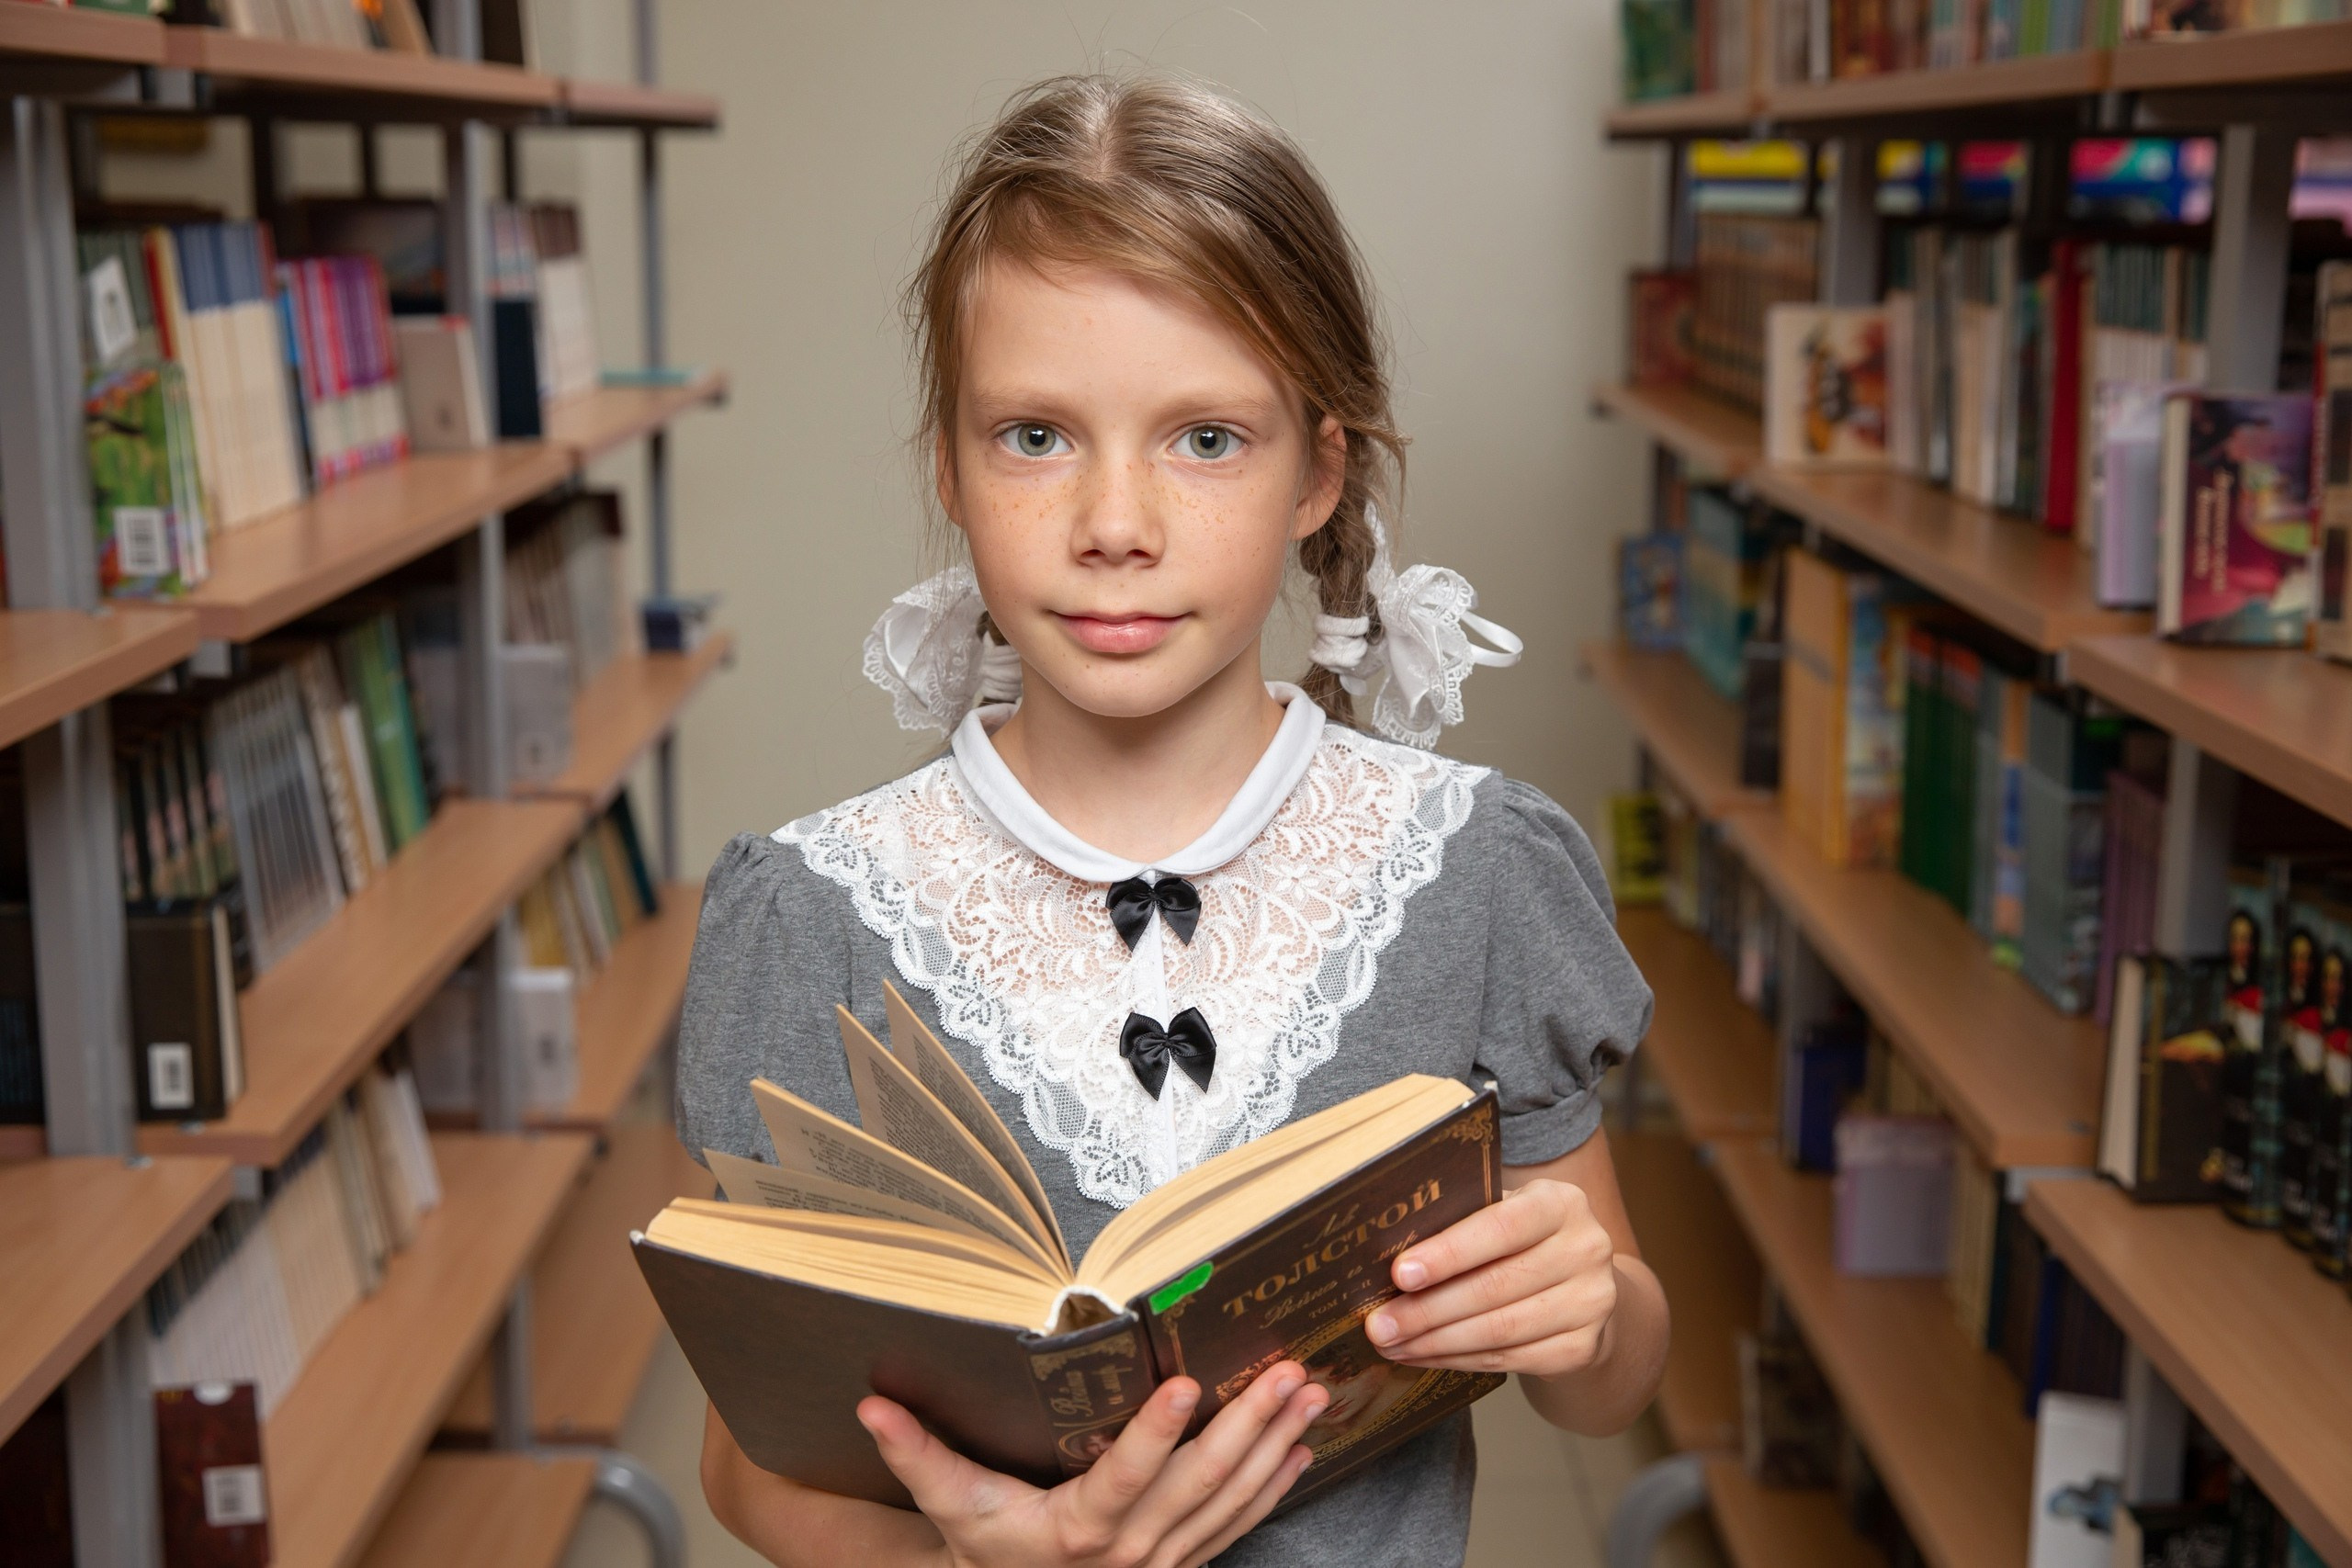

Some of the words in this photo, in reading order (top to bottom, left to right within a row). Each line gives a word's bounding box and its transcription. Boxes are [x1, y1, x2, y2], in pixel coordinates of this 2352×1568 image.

[1223, 1178, 1442, 1318] ТОЛСТОЙ
[1259, 1280, 1339, 1329] Война
[1347, 1266, 1363, 1279] и
